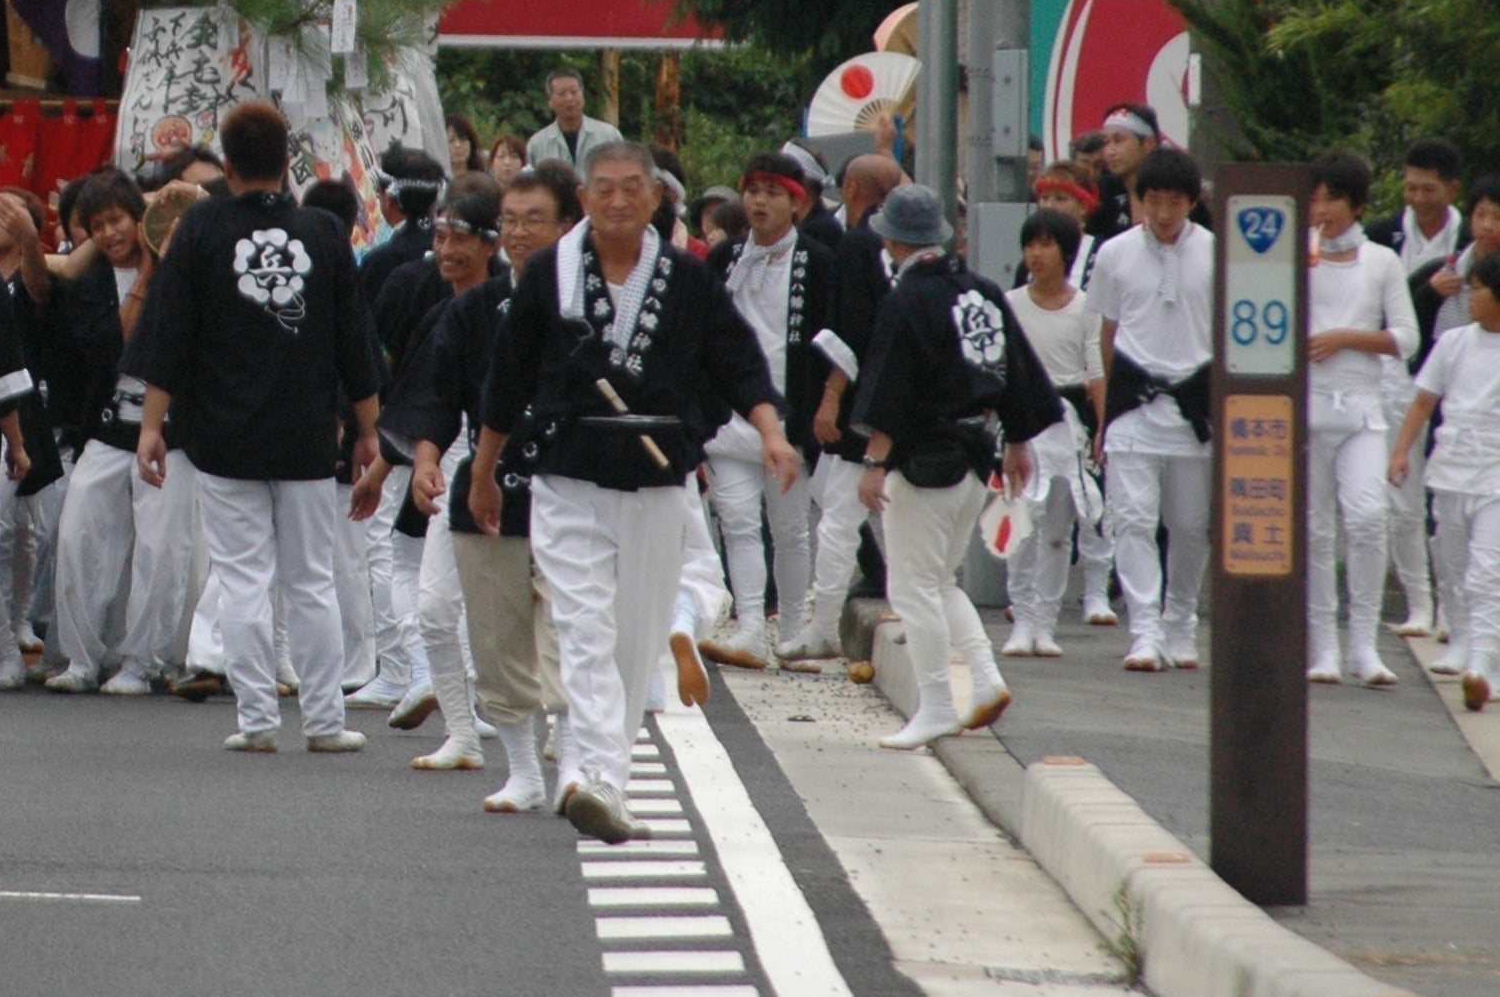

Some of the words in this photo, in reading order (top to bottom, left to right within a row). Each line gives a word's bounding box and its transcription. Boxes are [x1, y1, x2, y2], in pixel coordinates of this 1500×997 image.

[1244, 211, 1277, 239] 24
[249, 245, 293, 286] 兵
[1232, 299, 1288, 345] 89
